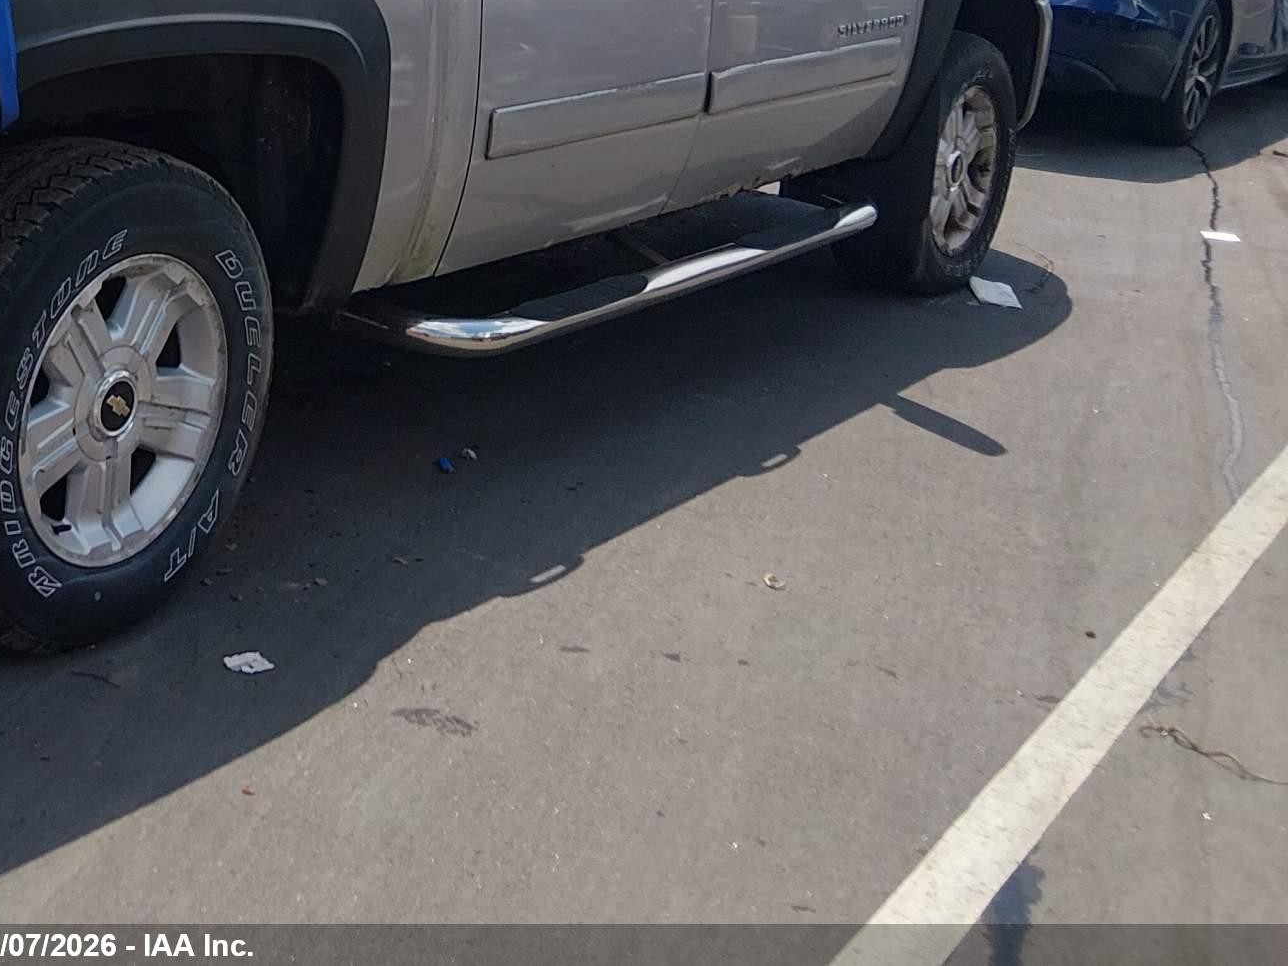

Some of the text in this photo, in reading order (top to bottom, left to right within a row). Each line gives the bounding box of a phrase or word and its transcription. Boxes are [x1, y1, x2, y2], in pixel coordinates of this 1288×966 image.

[0, 229, 128, 597] BRIDGESTONE
[163, 248, 261, 583] DUELER A/T
